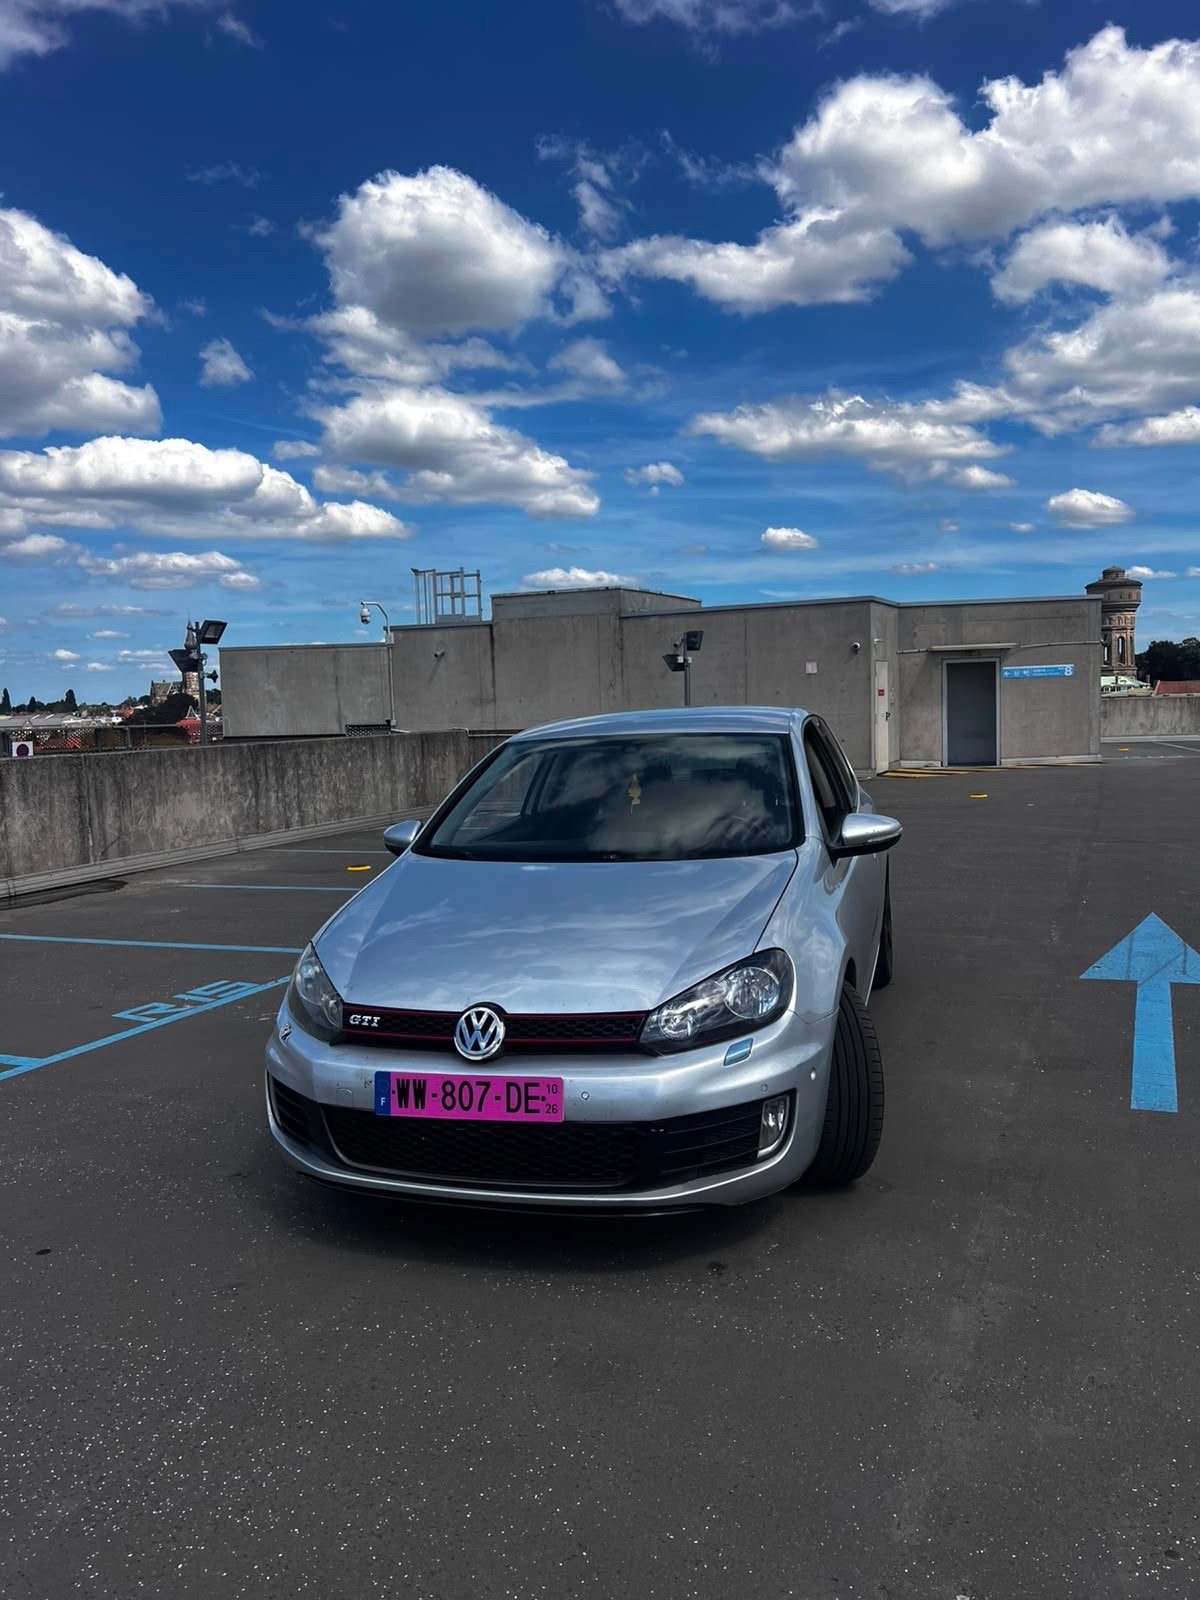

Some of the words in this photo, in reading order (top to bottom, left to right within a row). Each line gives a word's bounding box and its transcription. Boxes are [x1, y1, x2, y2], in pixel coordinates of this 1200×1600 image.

[1064, 666, 1073, 676] 8
[350, 1014, 381, 1027] GTI
[546, 1083, 558, 1094] 10
[380, 1097, 386, 1106] F
[545, 1103, 558, 1114] 26
